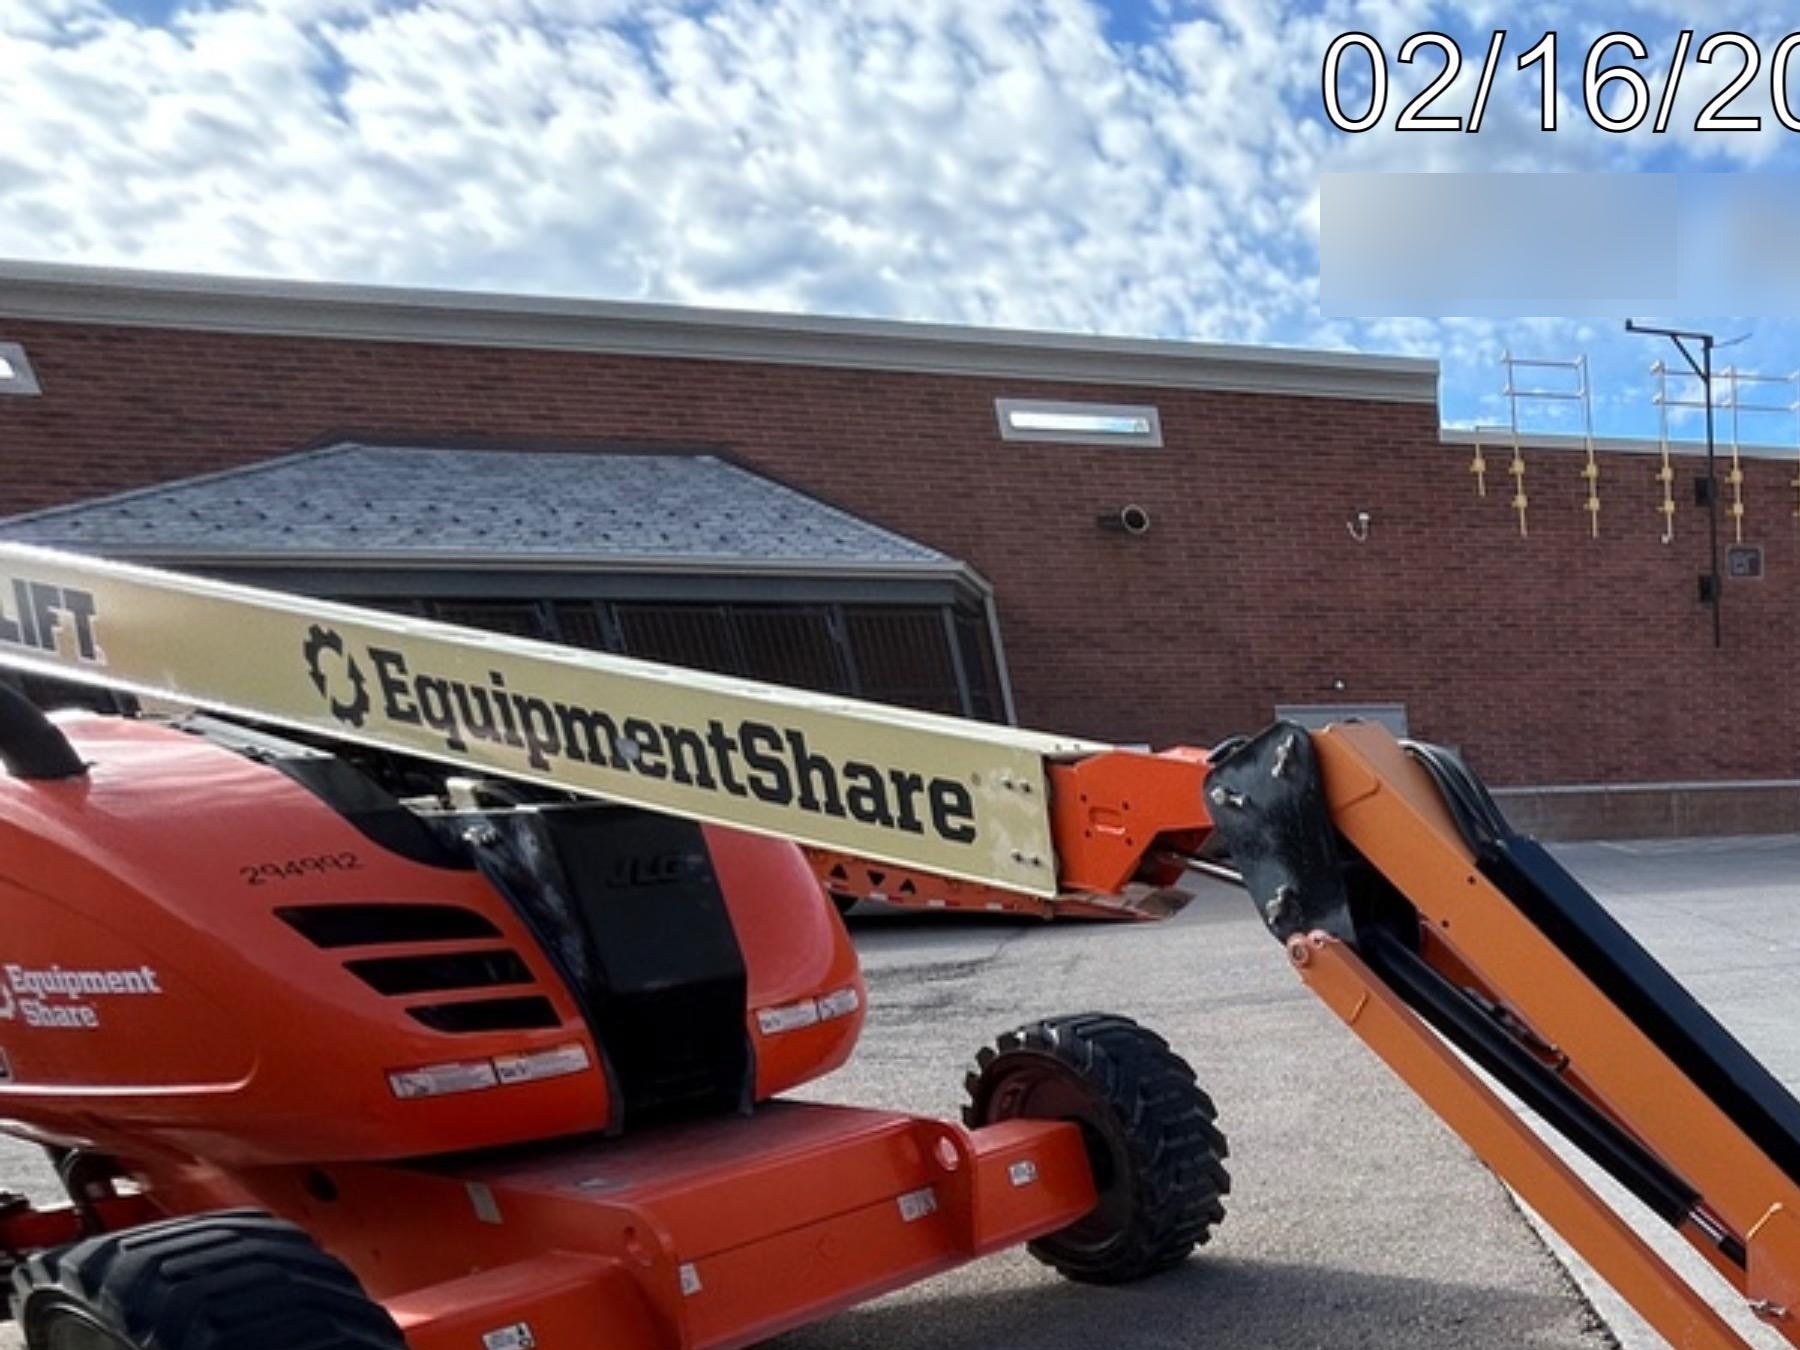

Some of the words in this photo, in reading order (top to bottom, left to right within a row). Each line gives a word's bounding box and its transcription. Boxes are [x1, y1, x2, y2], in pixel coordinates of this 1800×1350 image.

[366, 646, 977, 845] EquipmentShare
[239, 851, 366, 886] 294992
[5, 964, 163, 1000] Equipment
[19, 998, 99, 1028] Share
